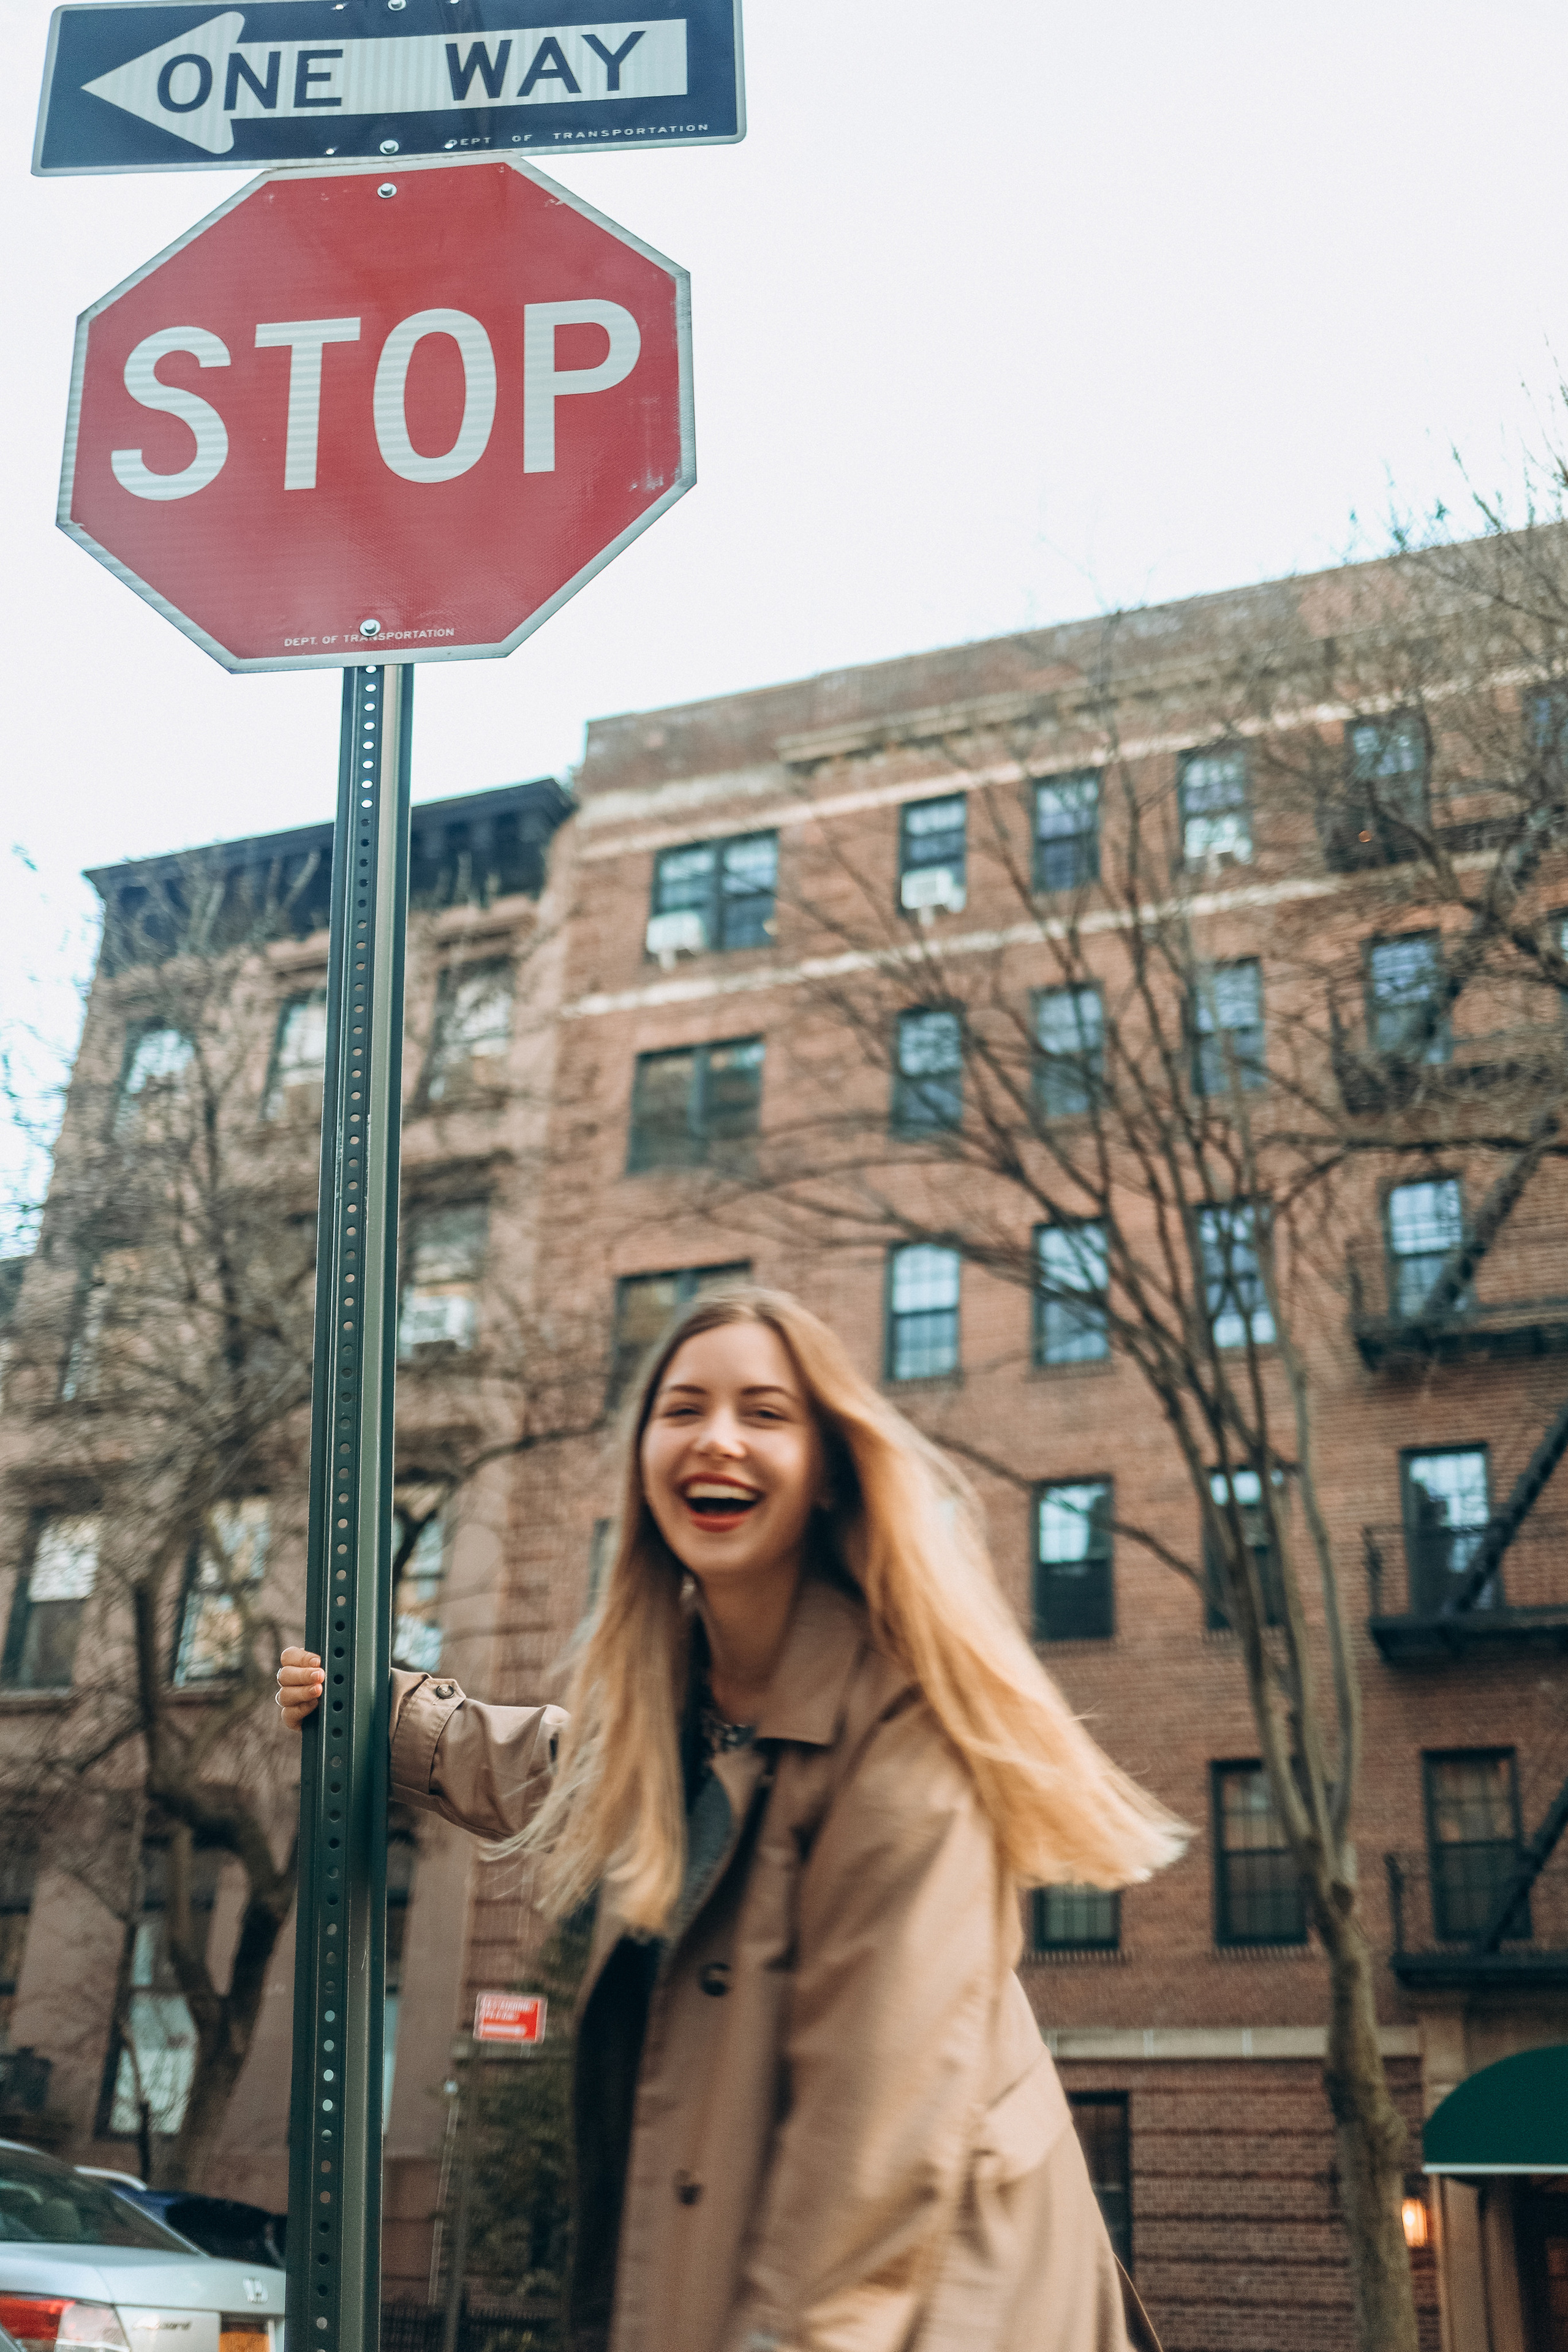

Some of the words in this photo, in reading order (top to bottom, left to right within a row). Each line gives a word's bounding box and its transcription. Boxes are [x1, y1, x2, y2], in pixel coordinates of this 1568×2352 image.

[157, 48, 344, 114] ONE
[445, 30, 647, 101] WAY
[552, 124, 709, 140] TRANSPORTATION
[110, 298, 642, 502] STOP
[284, 636, 318, 647] DEPT.
[322, 635, 338, 644] OF
